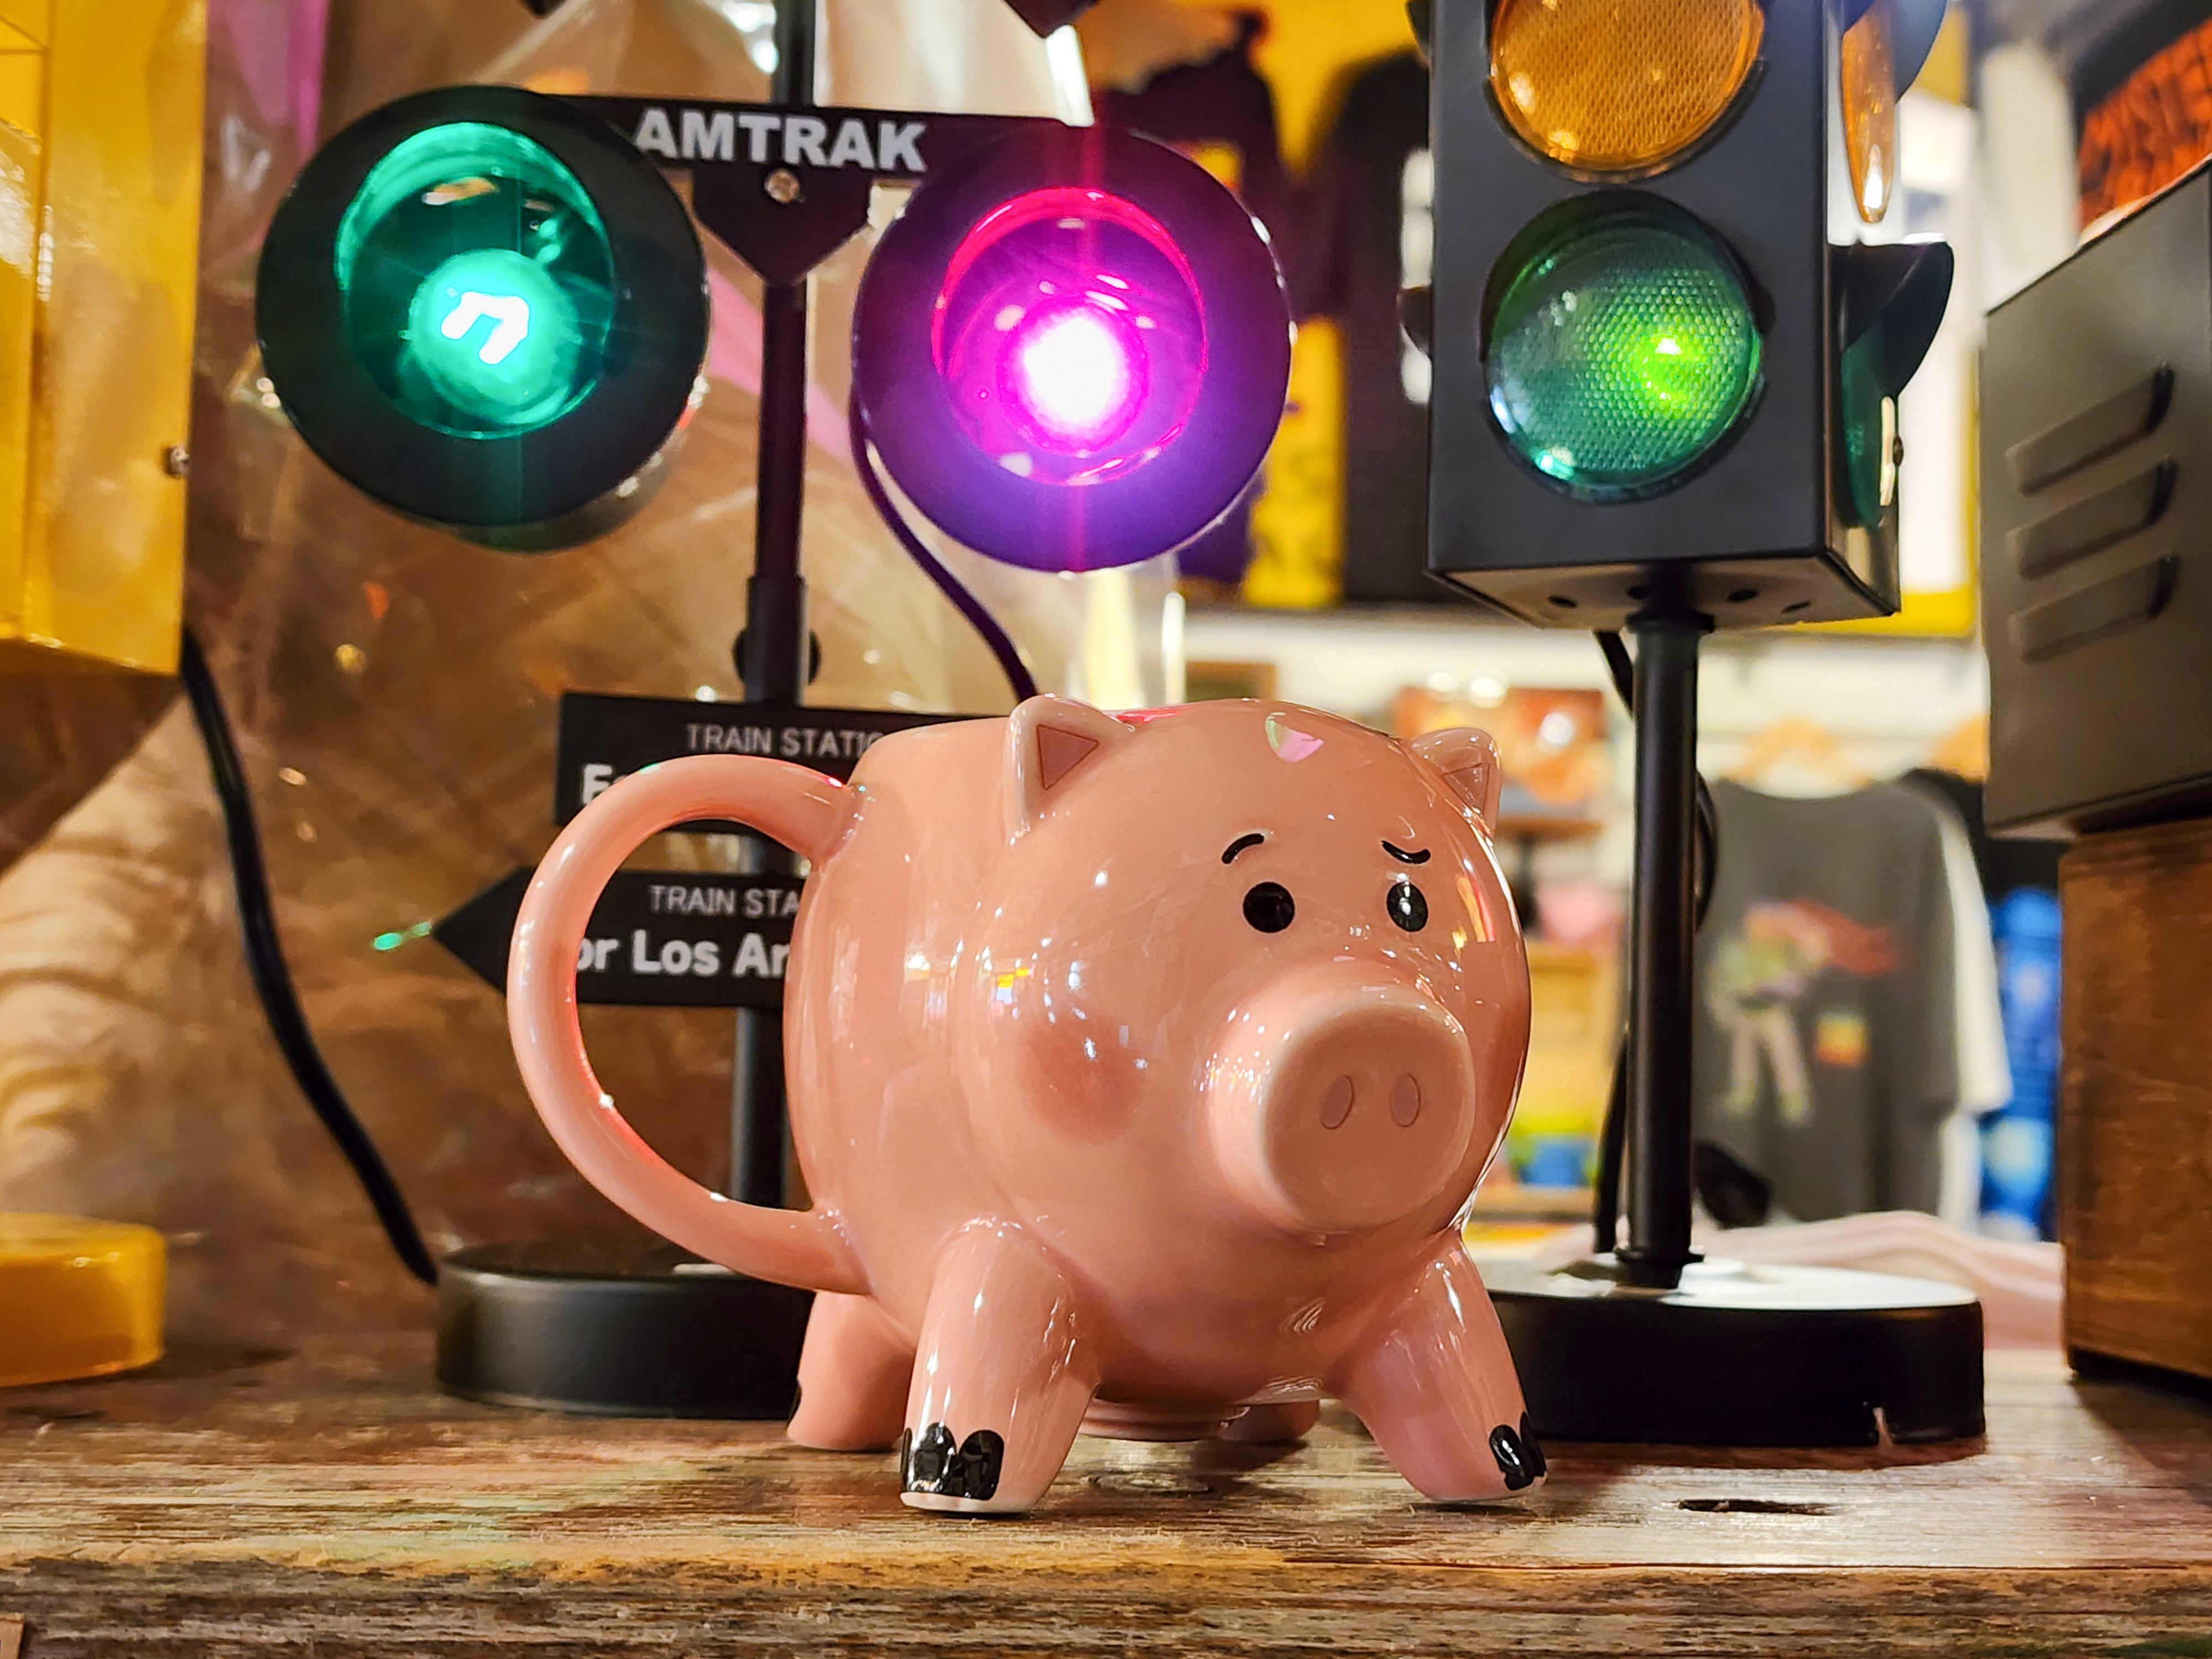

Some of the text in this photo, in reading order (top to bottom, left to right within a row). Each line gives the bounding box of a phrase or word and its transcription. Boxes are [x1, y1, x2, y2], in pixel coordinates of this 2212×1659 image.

[635, 108, 927, 171] AMTRAK
[685, 723, 772, 754] TRAIN
[650, 885, 799, 919] TRAIN STA
[577, 938, 619, 970] or
[632, 929, 720, 976] Los
